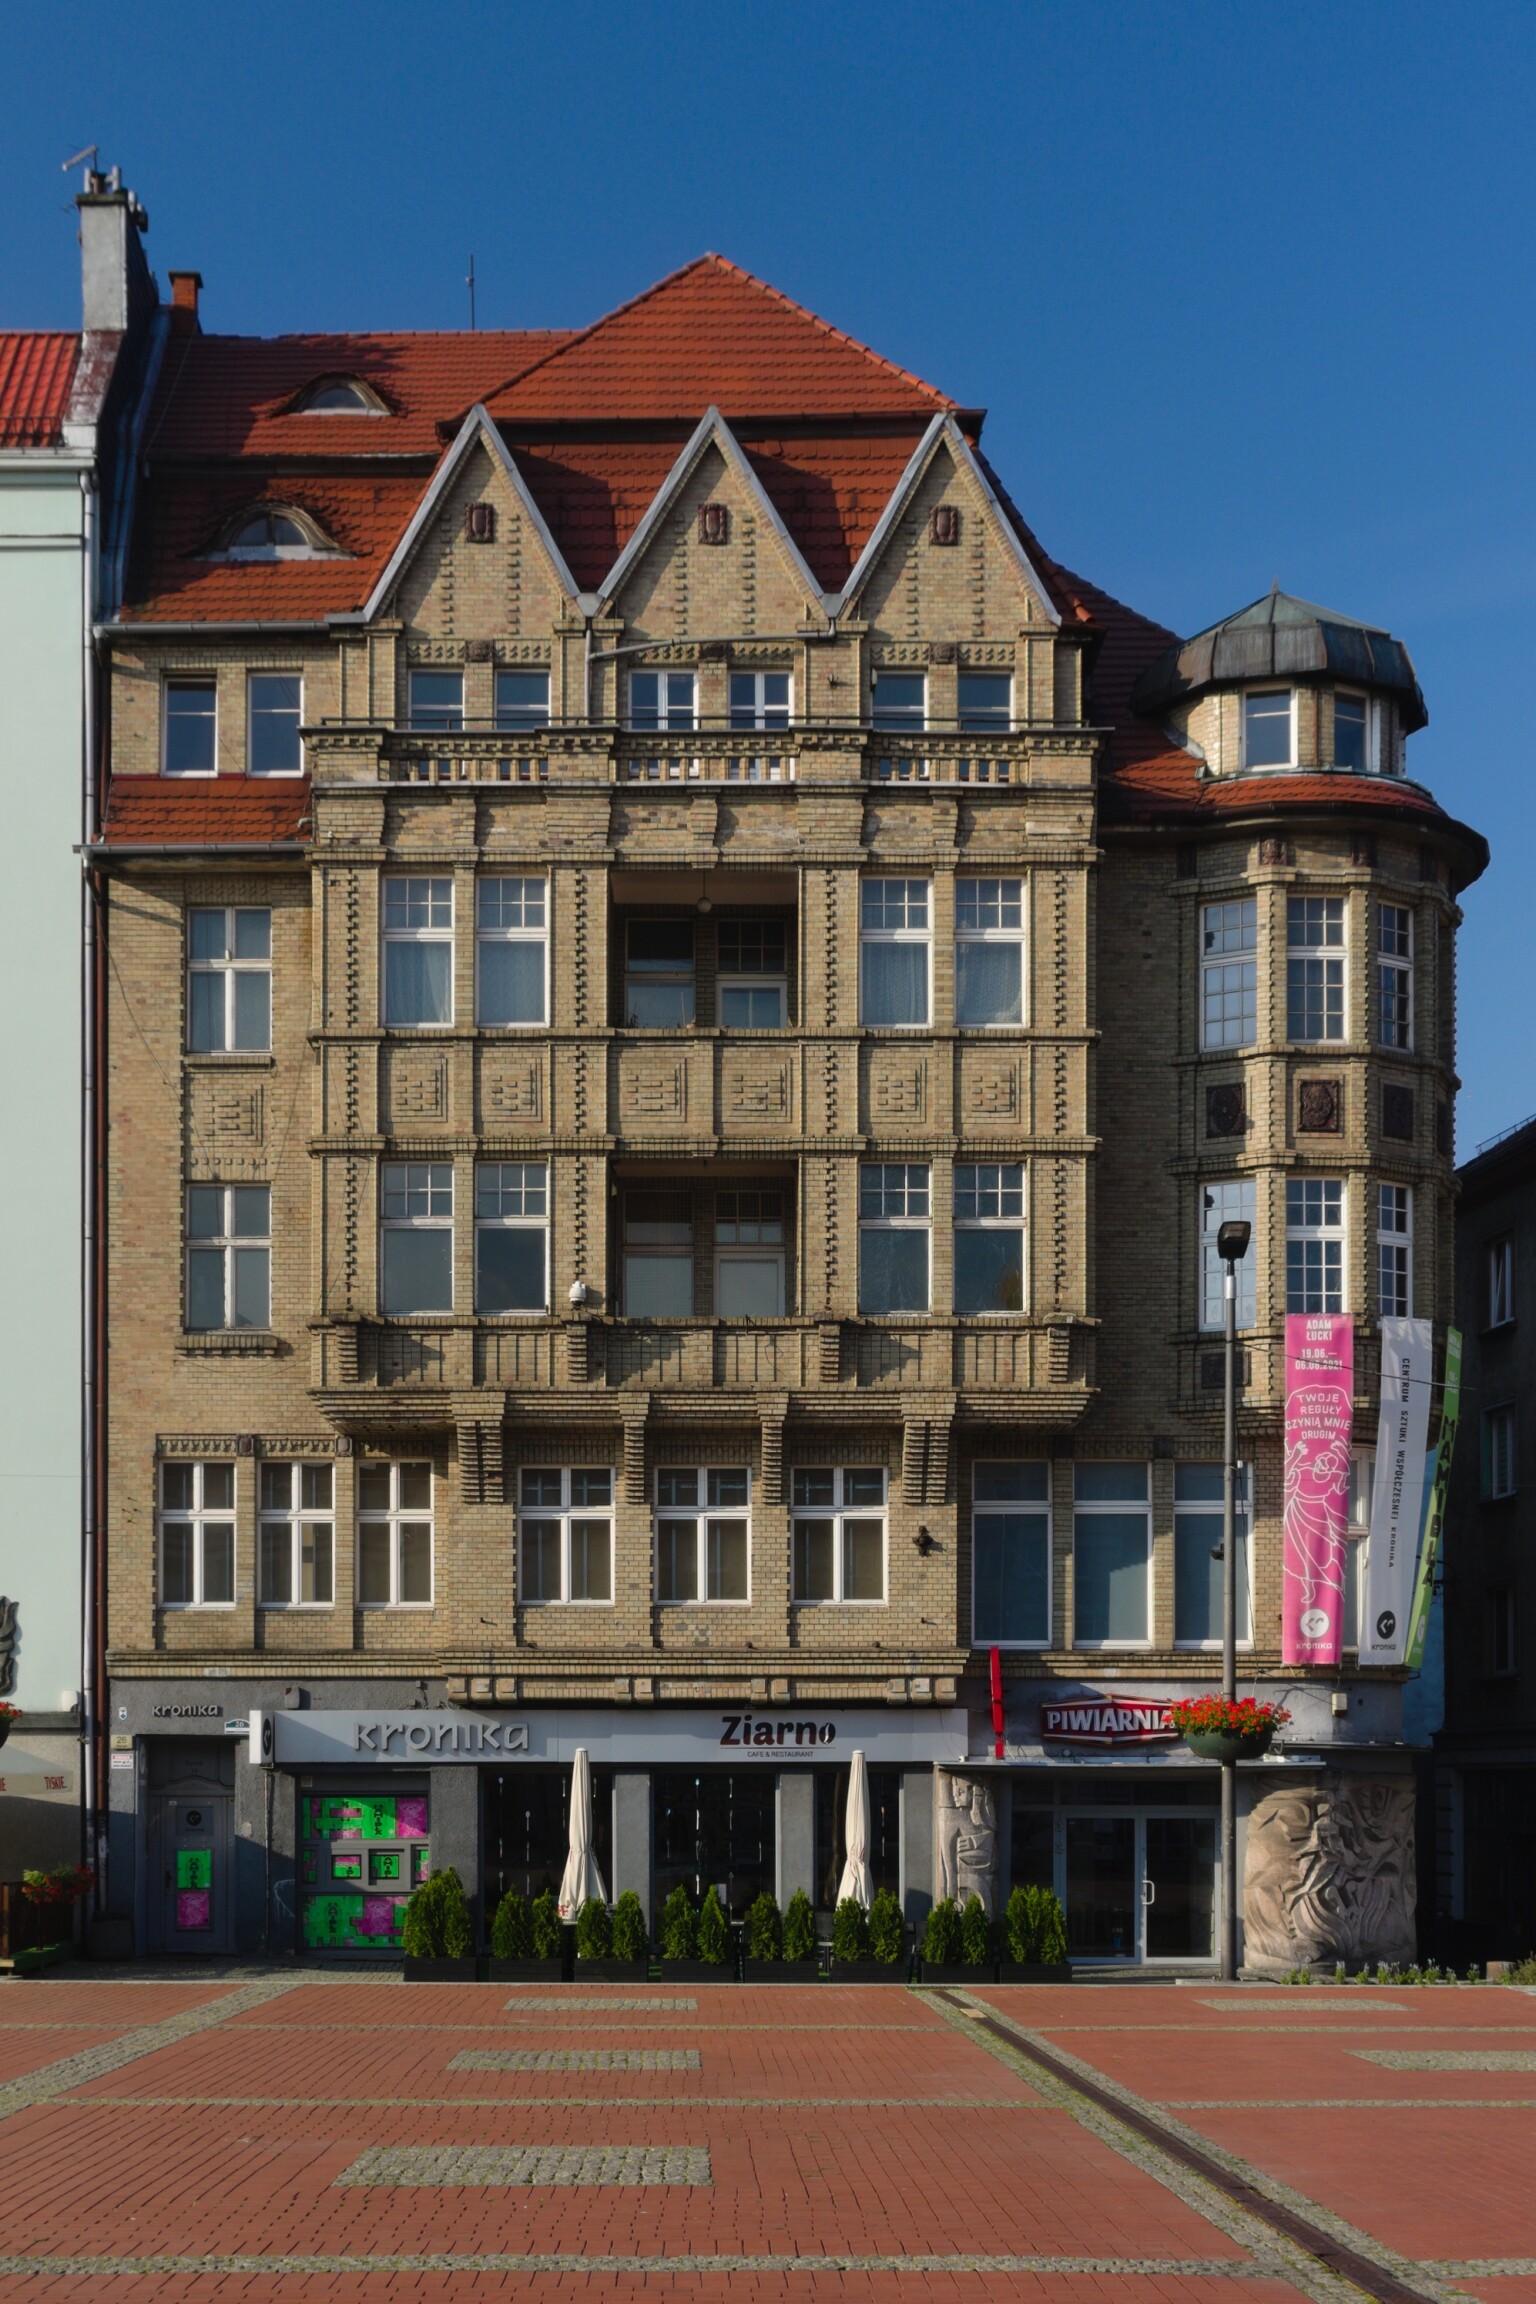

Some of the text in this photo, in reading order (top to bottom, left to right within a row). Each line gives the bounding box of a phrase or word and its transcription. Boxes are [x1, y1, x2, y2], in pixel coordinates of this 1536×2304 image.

[1306, 1319, 1332, 1330] ADAM
[1306, 1331, 1333, 1341] ŁUCKI
[1401, 1358, 1410, 1403] CENTRUM
[1296, 1393, 1340, 1403] TWOJE
[1300, 1404, 1342, 1415] REGUŁY
[1285, 1416, 1352, 1431] CZYNIĄ MNIE
[1398, 1410, 1408, 1443] SZTUKI
[1301, 1429, 1336, 1441] DRUGIM
[1388, 1527, 1397, 1568] KRONIKA
[1296, 1641, 1333, 1650] kronika
[1371, 1643, 1396, 1651] kronika
[152, 1704, 220, 1716] kronika
[720, 1714, 836, 1746] Ziarno
[116, 1736, 127, 1744] 26
[354, 1722, 530, 1751] kronika
